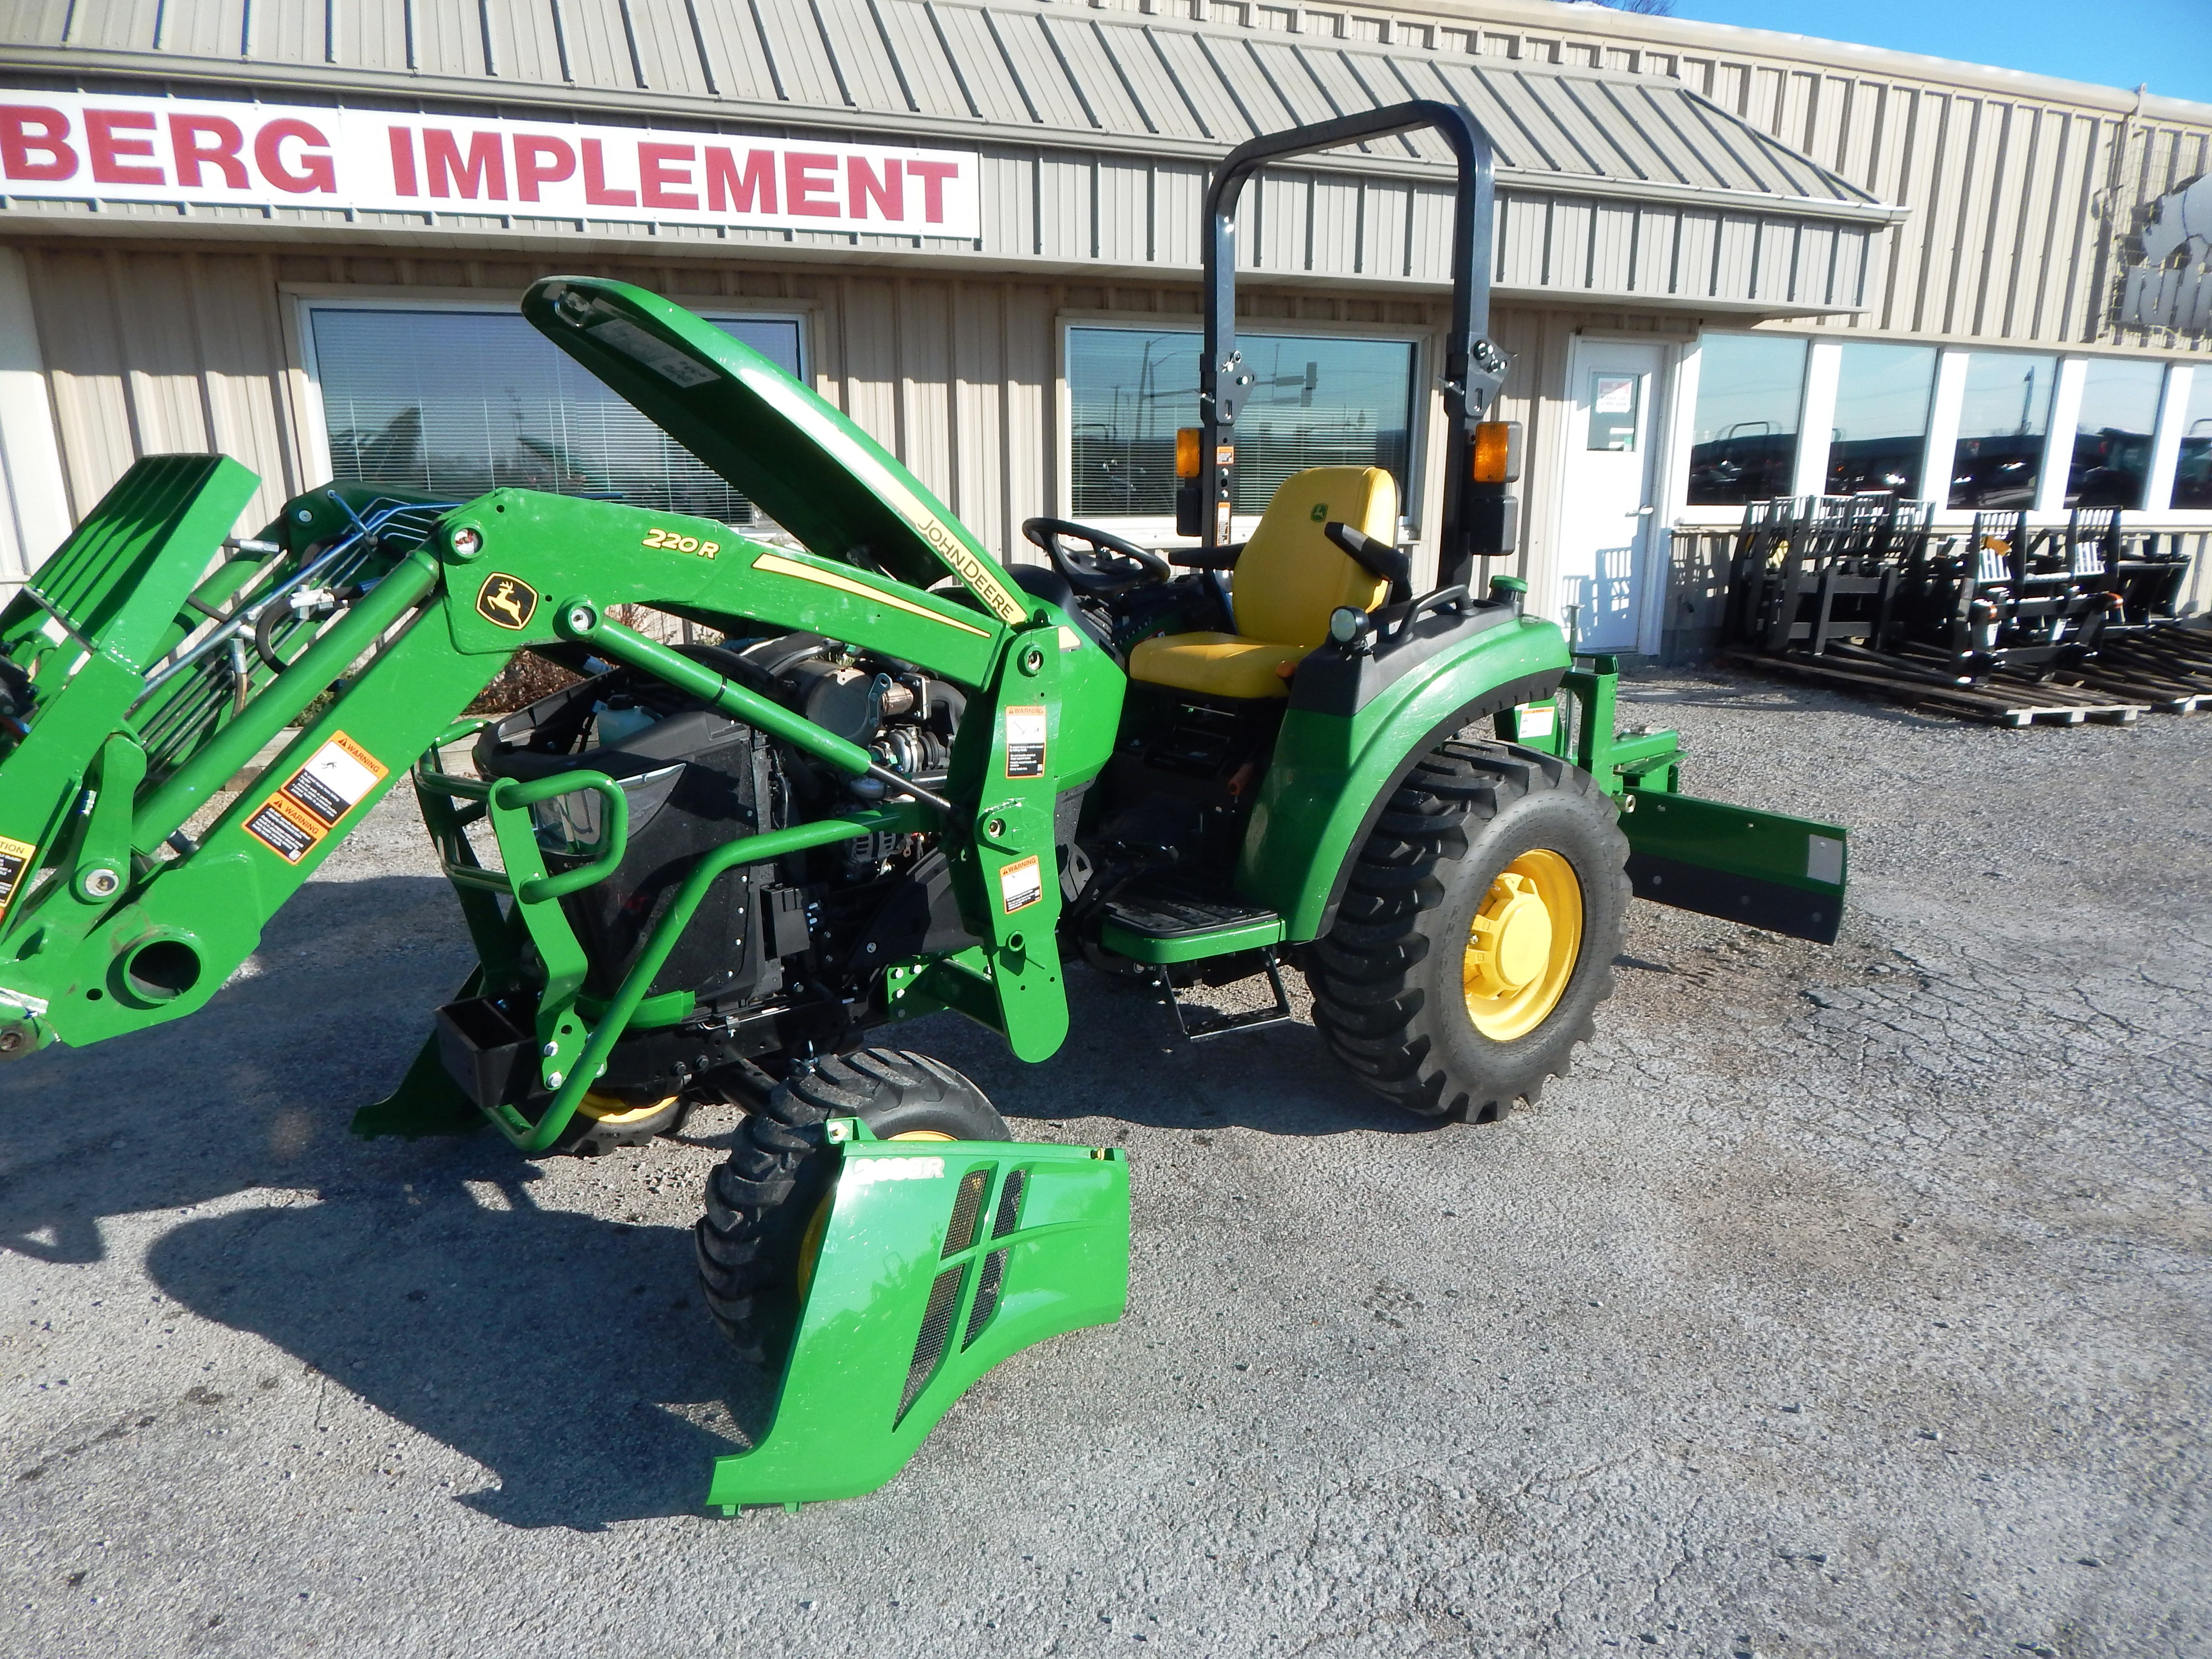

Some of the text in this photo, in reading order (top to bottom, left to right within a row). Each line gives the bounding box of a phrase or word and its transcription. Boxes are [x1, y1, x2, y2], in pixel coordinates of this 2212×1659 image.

[0, 105, 959, 224] BERG IMPLEMENT
[641, 528, 721, 559] 220R
[917, 519, 1014, 618] JOHN DEERE
[347, 743, 380, 773] WARNING
[285, 806, 319, 835] WARNING
[1008, 857, 1036, 872] WARNING
